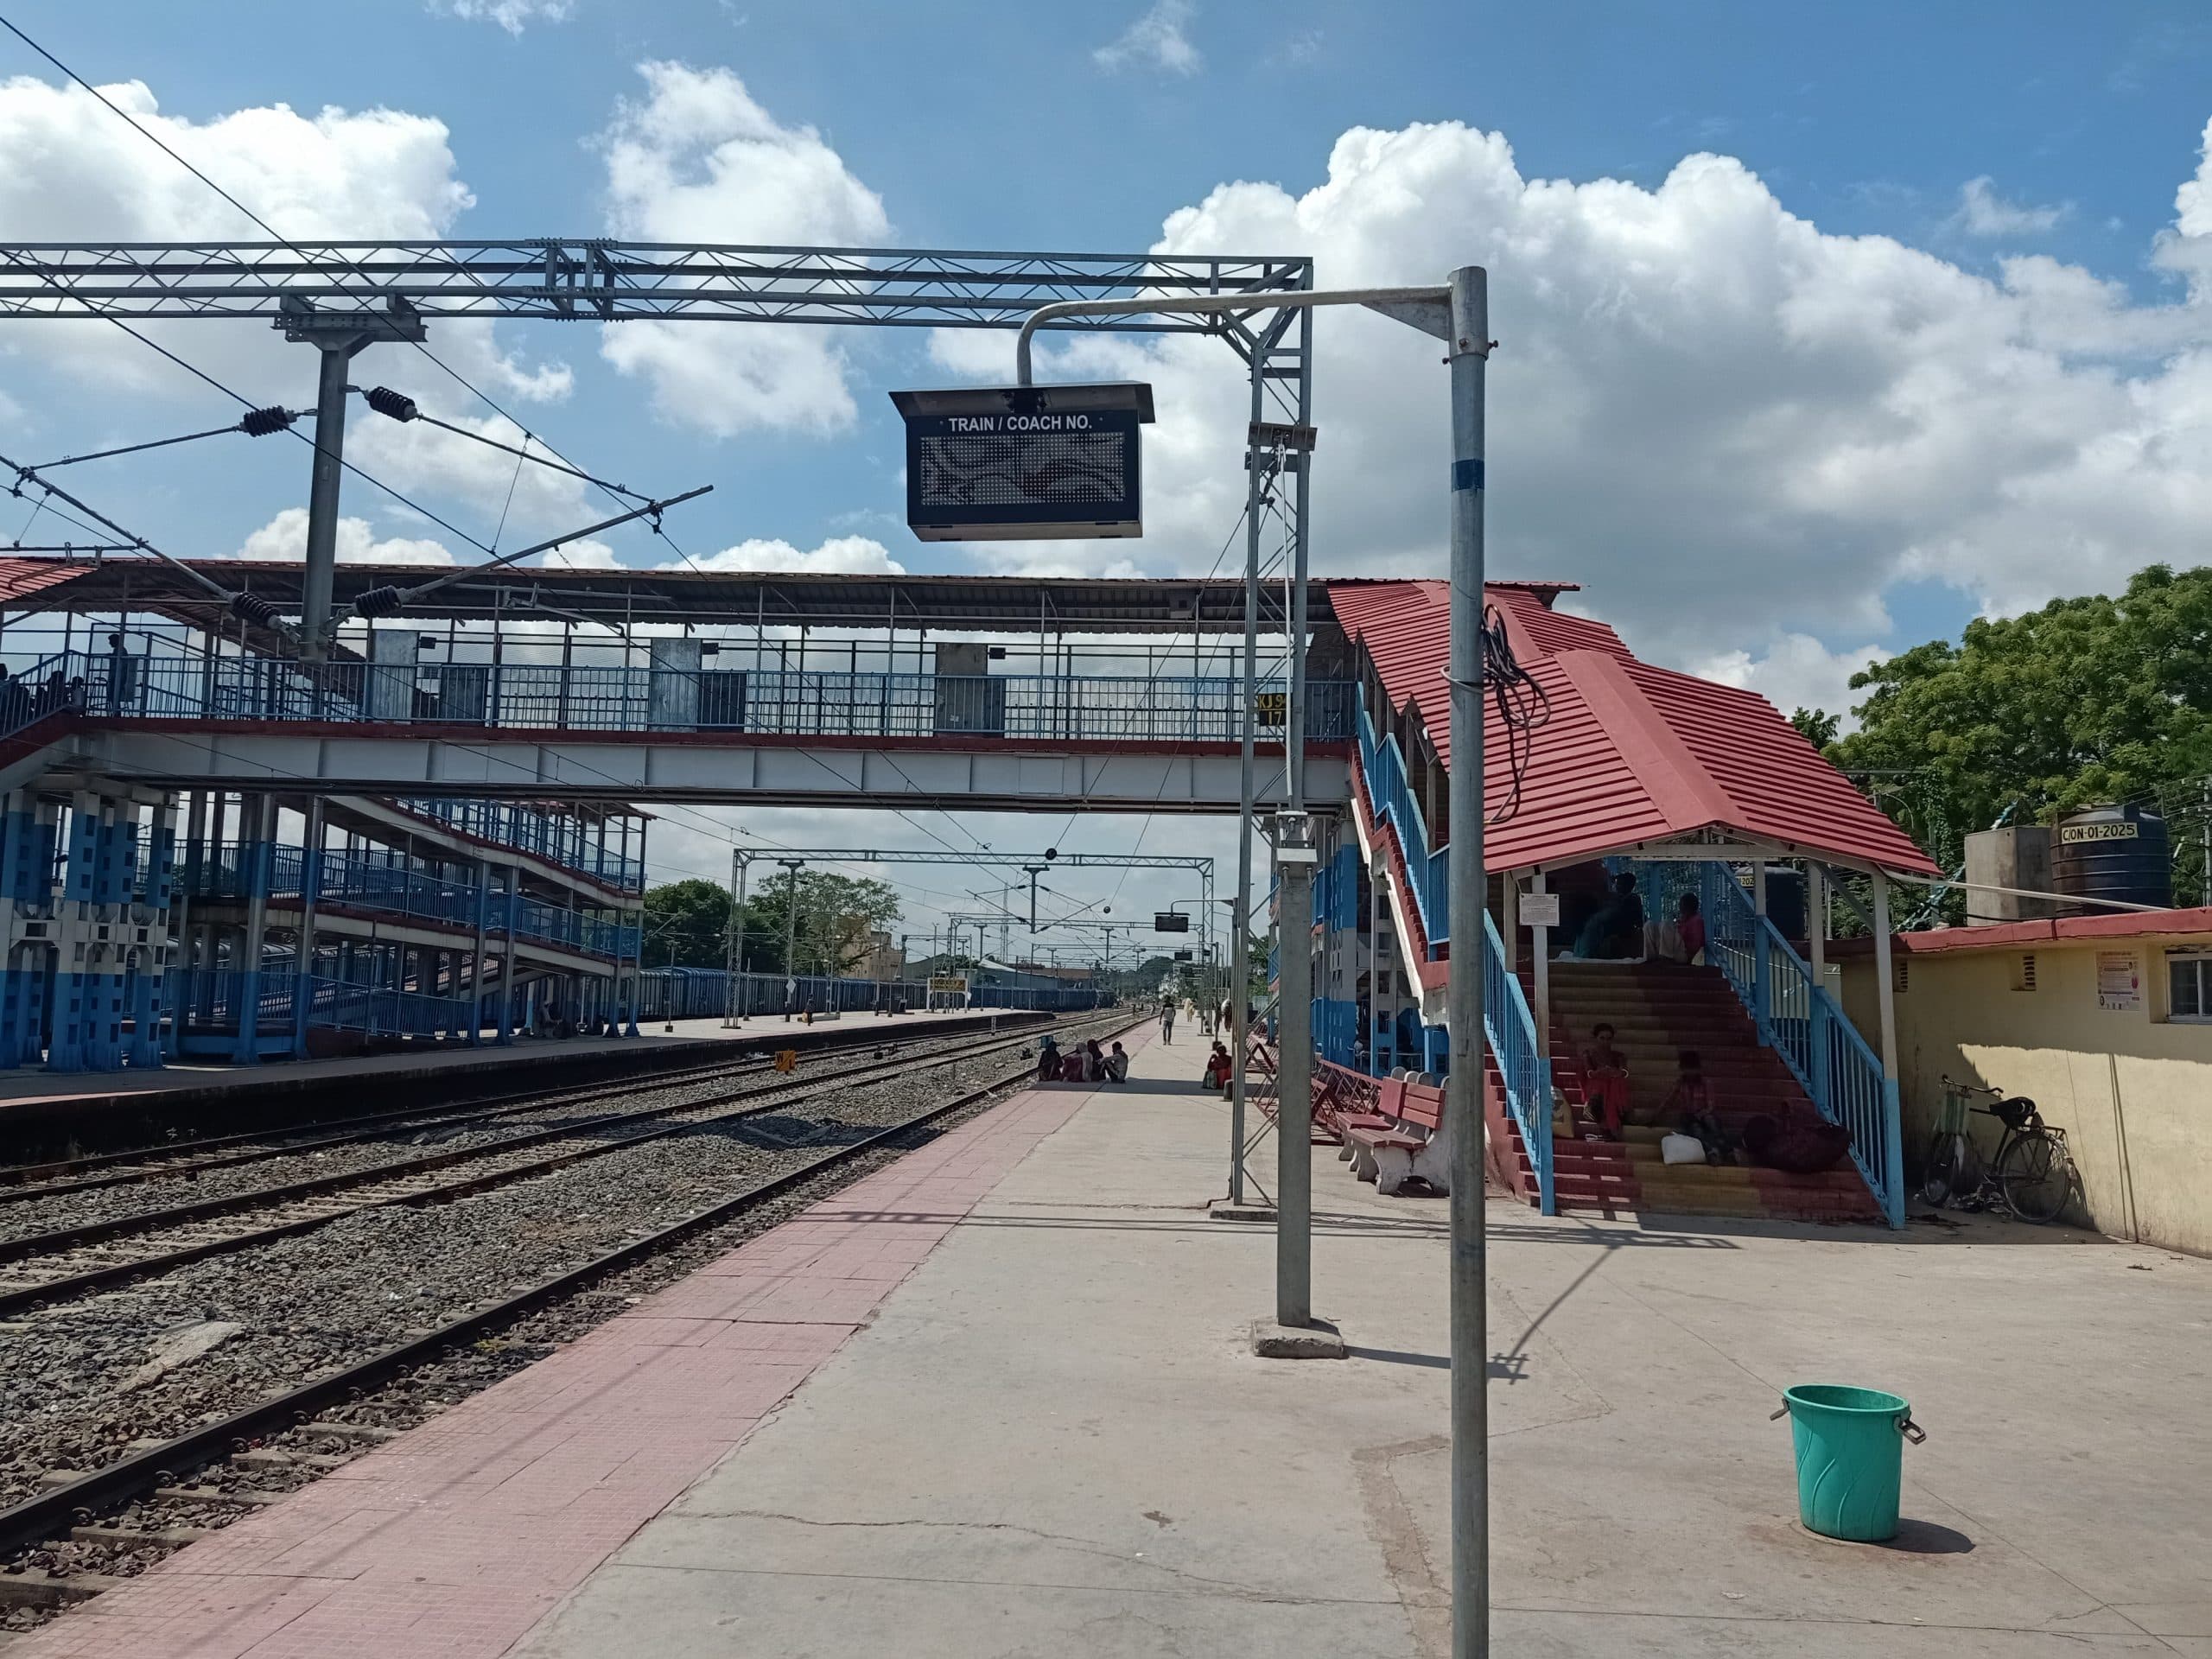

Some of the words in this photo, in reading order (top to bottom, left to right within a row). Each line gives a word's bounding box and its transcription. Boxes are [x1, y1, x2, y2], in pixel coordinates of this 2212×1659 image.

[949, 416, 994, 432] TRAIN
[998, 416, 1003, 431] /
[1007, 416, 1061, 430] COACH
[1066, 415, 1092, 429] NO.
